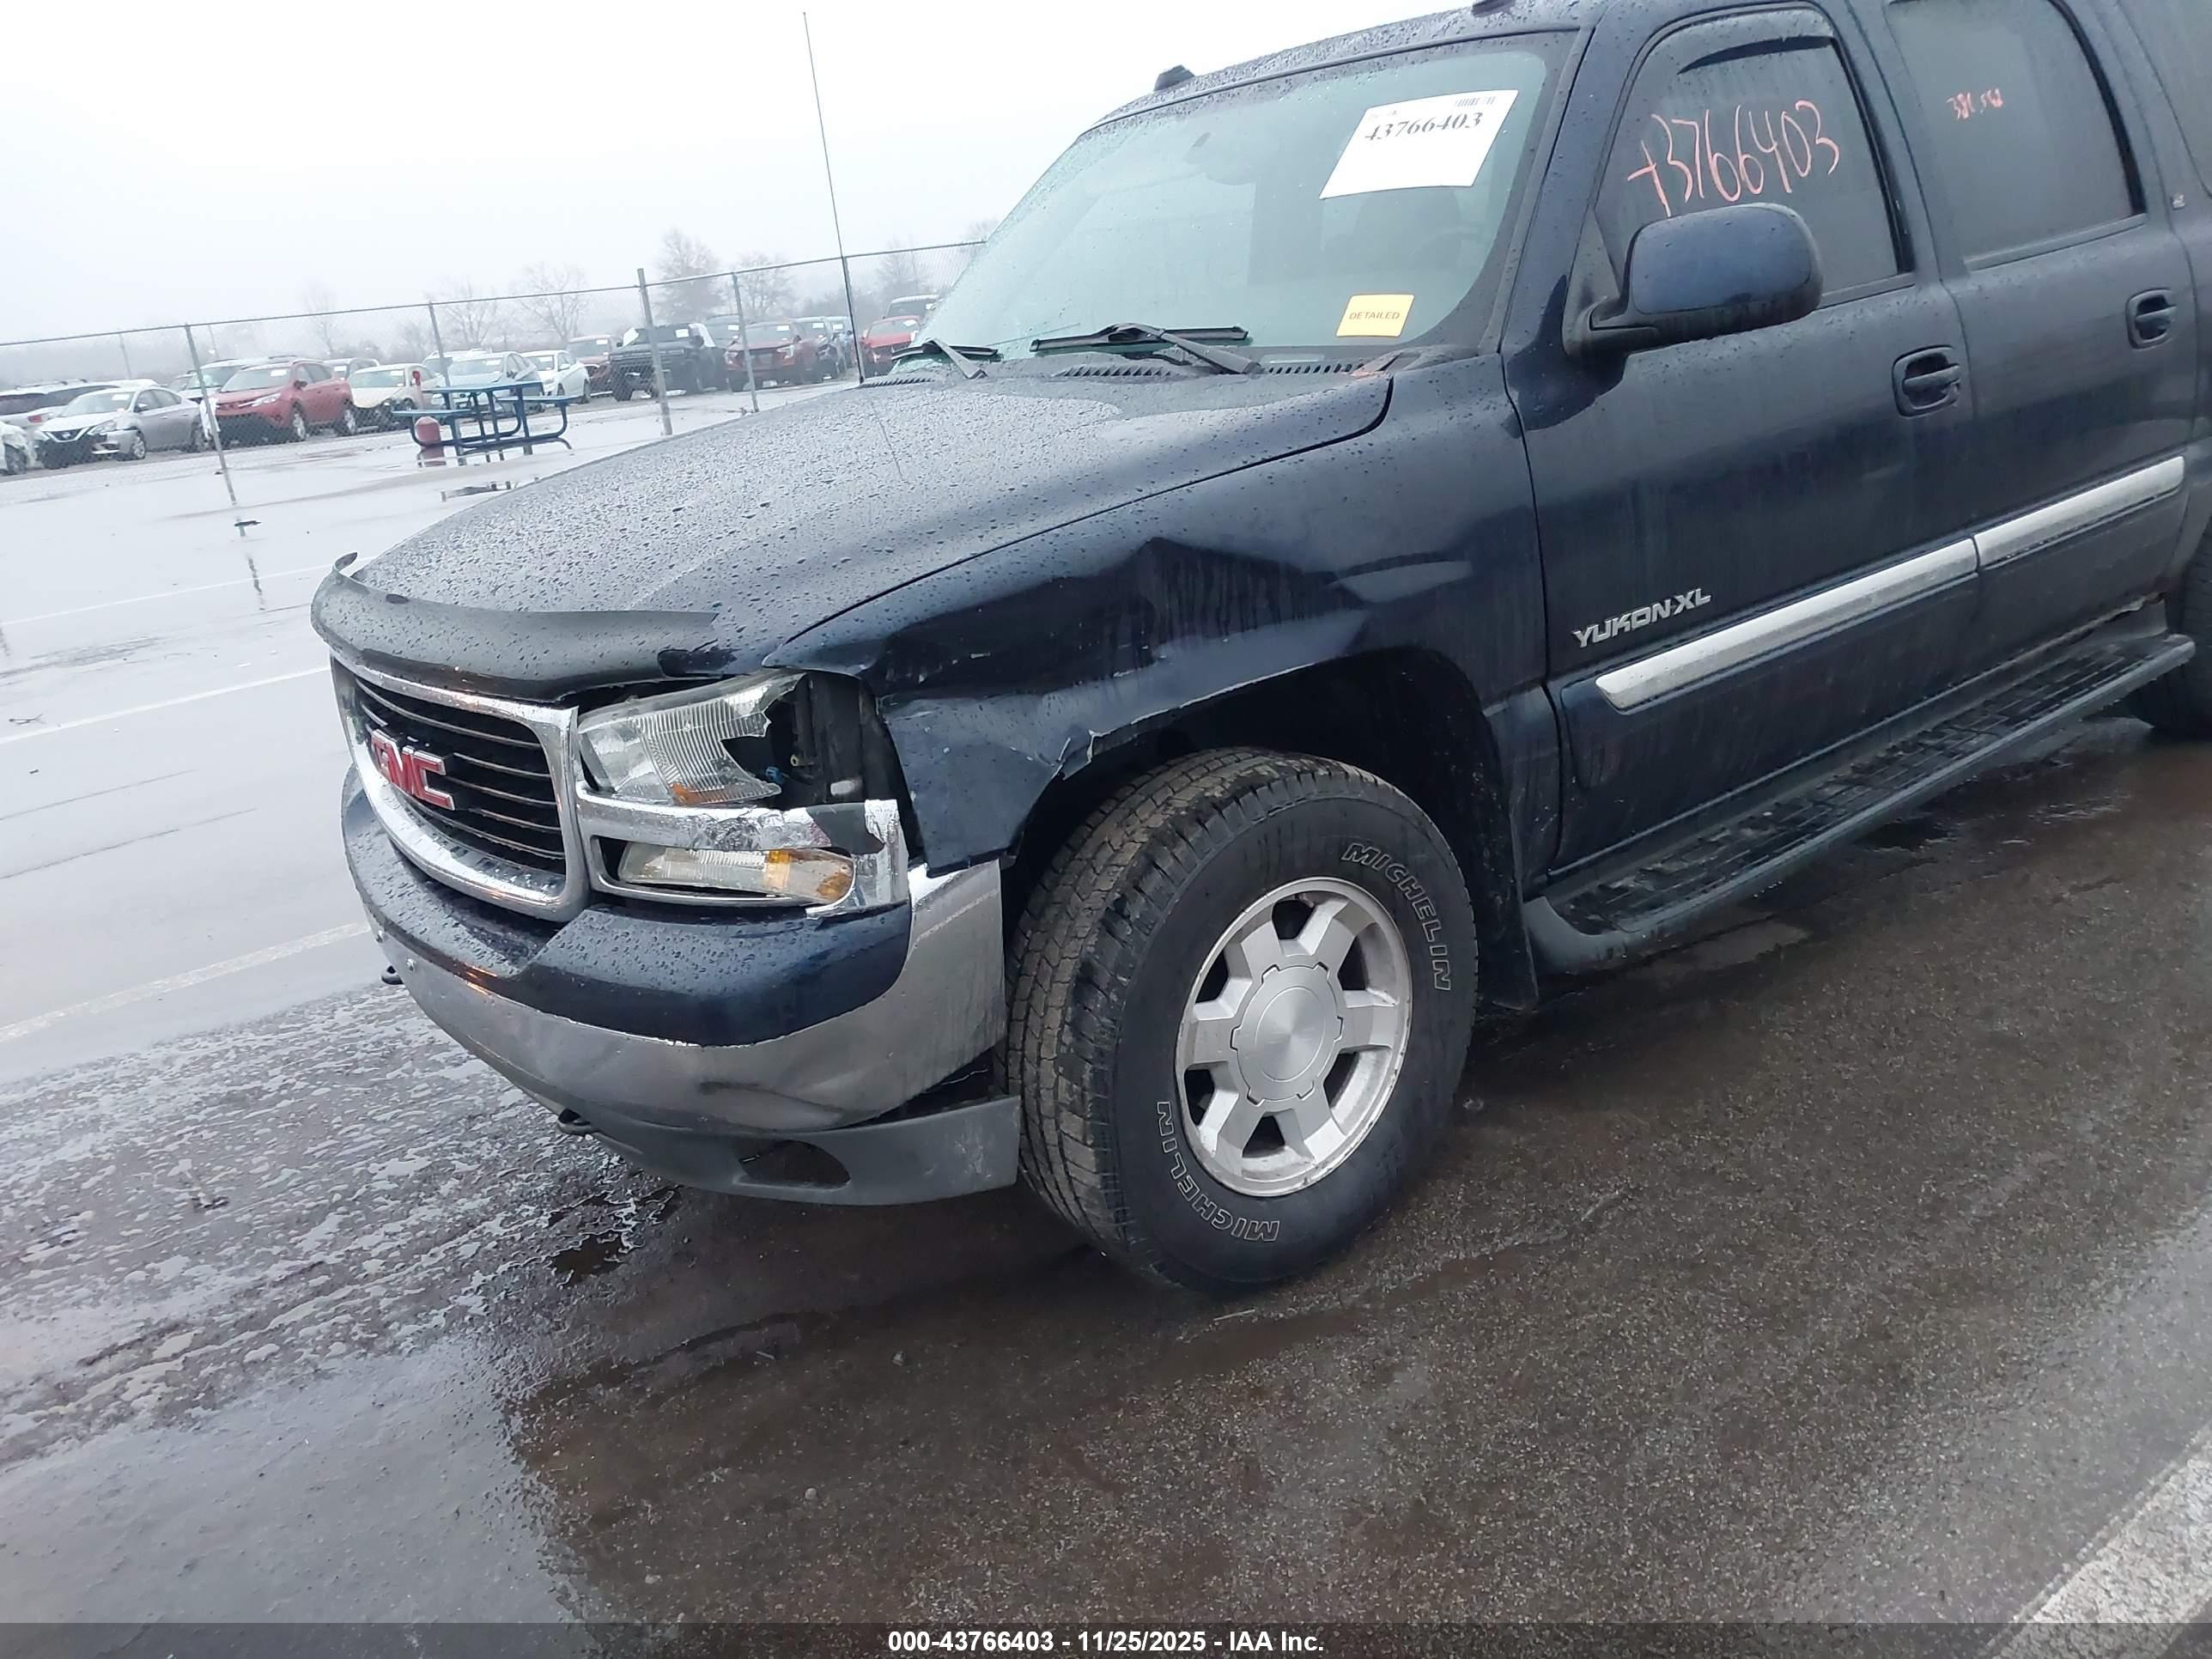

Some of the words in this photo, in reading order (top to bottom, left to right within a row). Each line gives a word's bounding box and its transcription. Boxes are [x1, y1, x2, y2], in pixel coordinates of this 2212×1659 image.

[1364, 112, 1483, 141] 43766403
[1348, 310, 1401, 321] DETAILED
[1572, 599, 1672, 649] YUKON
[1673, 587, 1713, 616] XL
[1340, 842, 1453, 992] MICHELIN
[1156, 1100, 1281, 1243] MICHELIN
